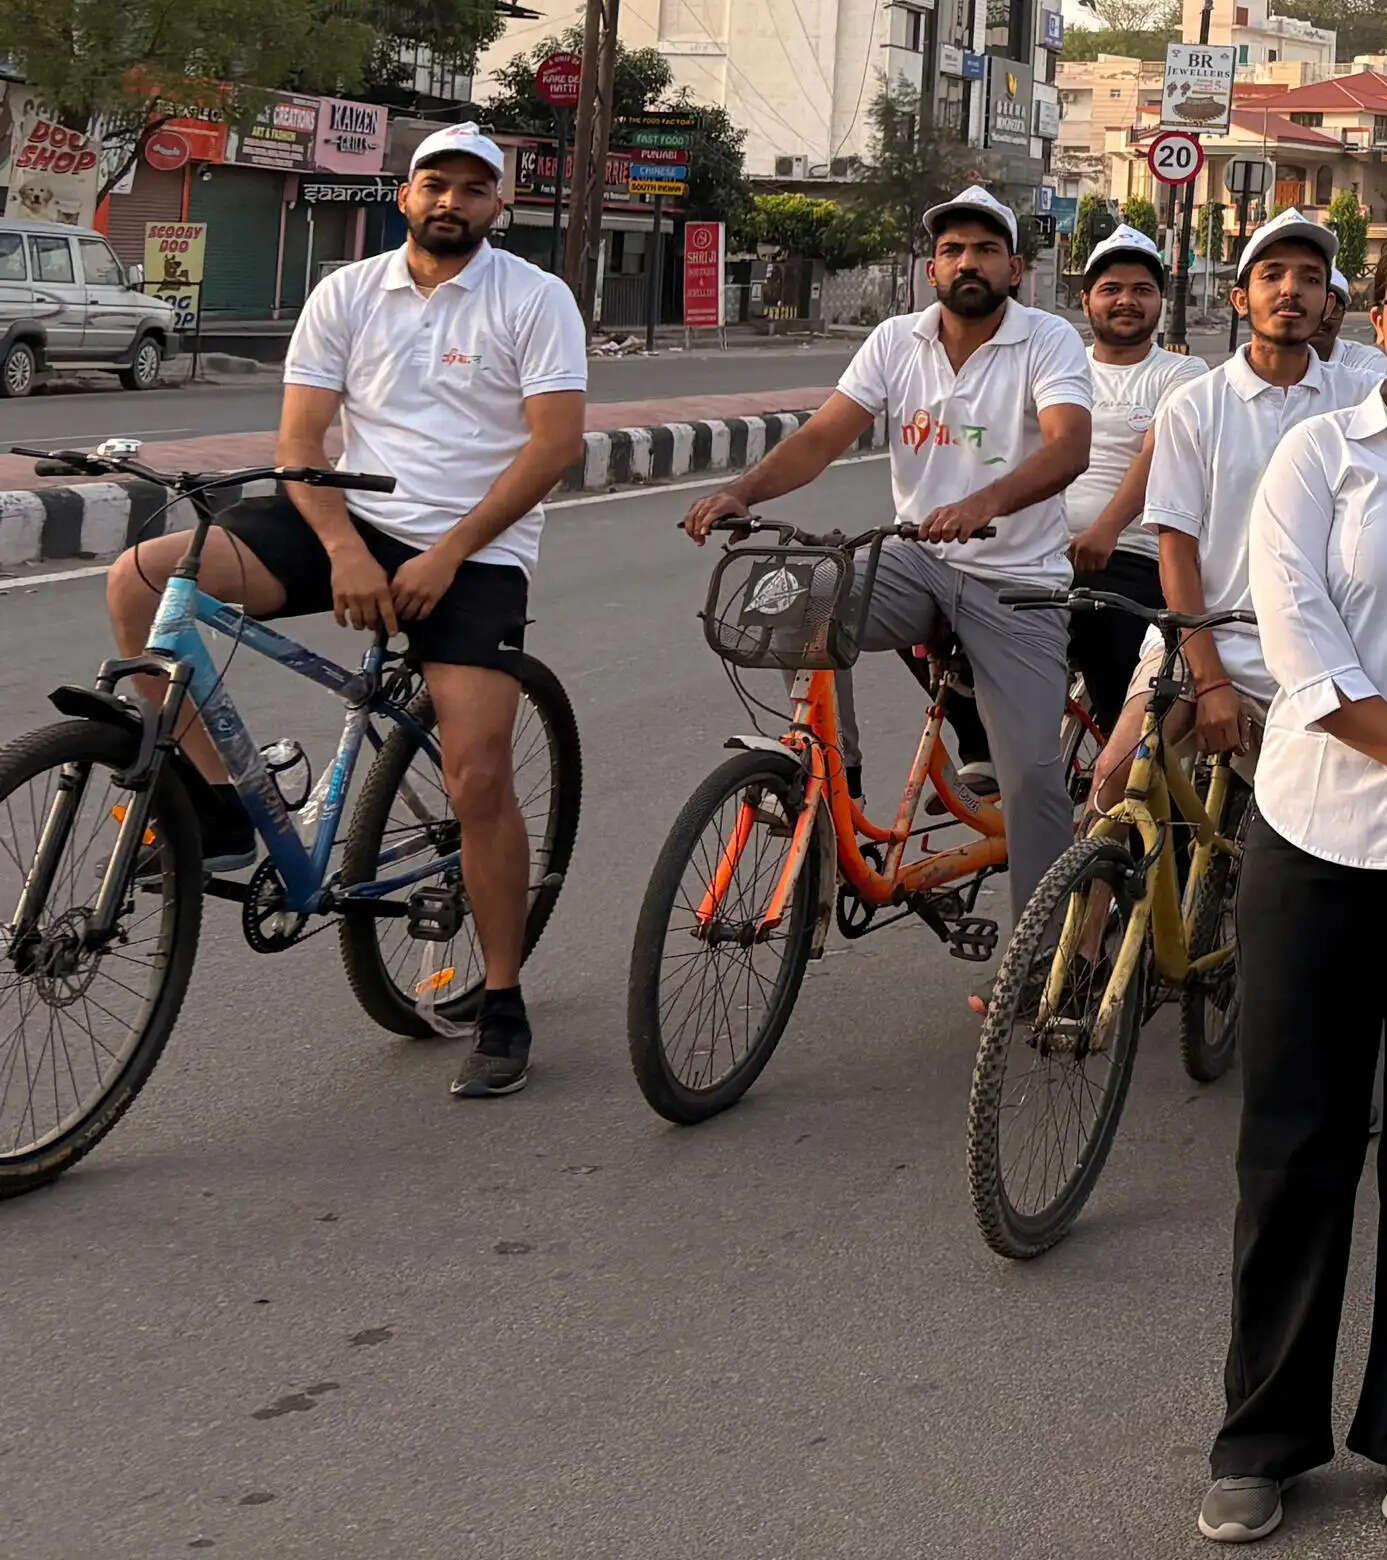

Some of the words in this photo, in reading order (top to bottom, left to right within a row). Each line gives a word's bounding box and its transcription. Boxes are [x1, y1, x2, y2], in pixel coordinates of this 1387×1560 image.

[1189, 53, 1213, 69] BR
[1167, 65, 1230, 79] JEWELLERS
[332, 104, 378, 135] KAIZEN
[637, 133, 657, 143] FAST
[659, 135, 685, 145] FOOD
[16, 144, 96, 175] SHOP
[641, 150, 677, 160] PUNJABI
[1158, 146, 1191, 169] 20
[631, 183, 656, 192] SOUTH
[149, 225, 203, 239] SCOOBY
[159, 240, 189, 253] DOO
[687, 251, 707, 264] SHRI
